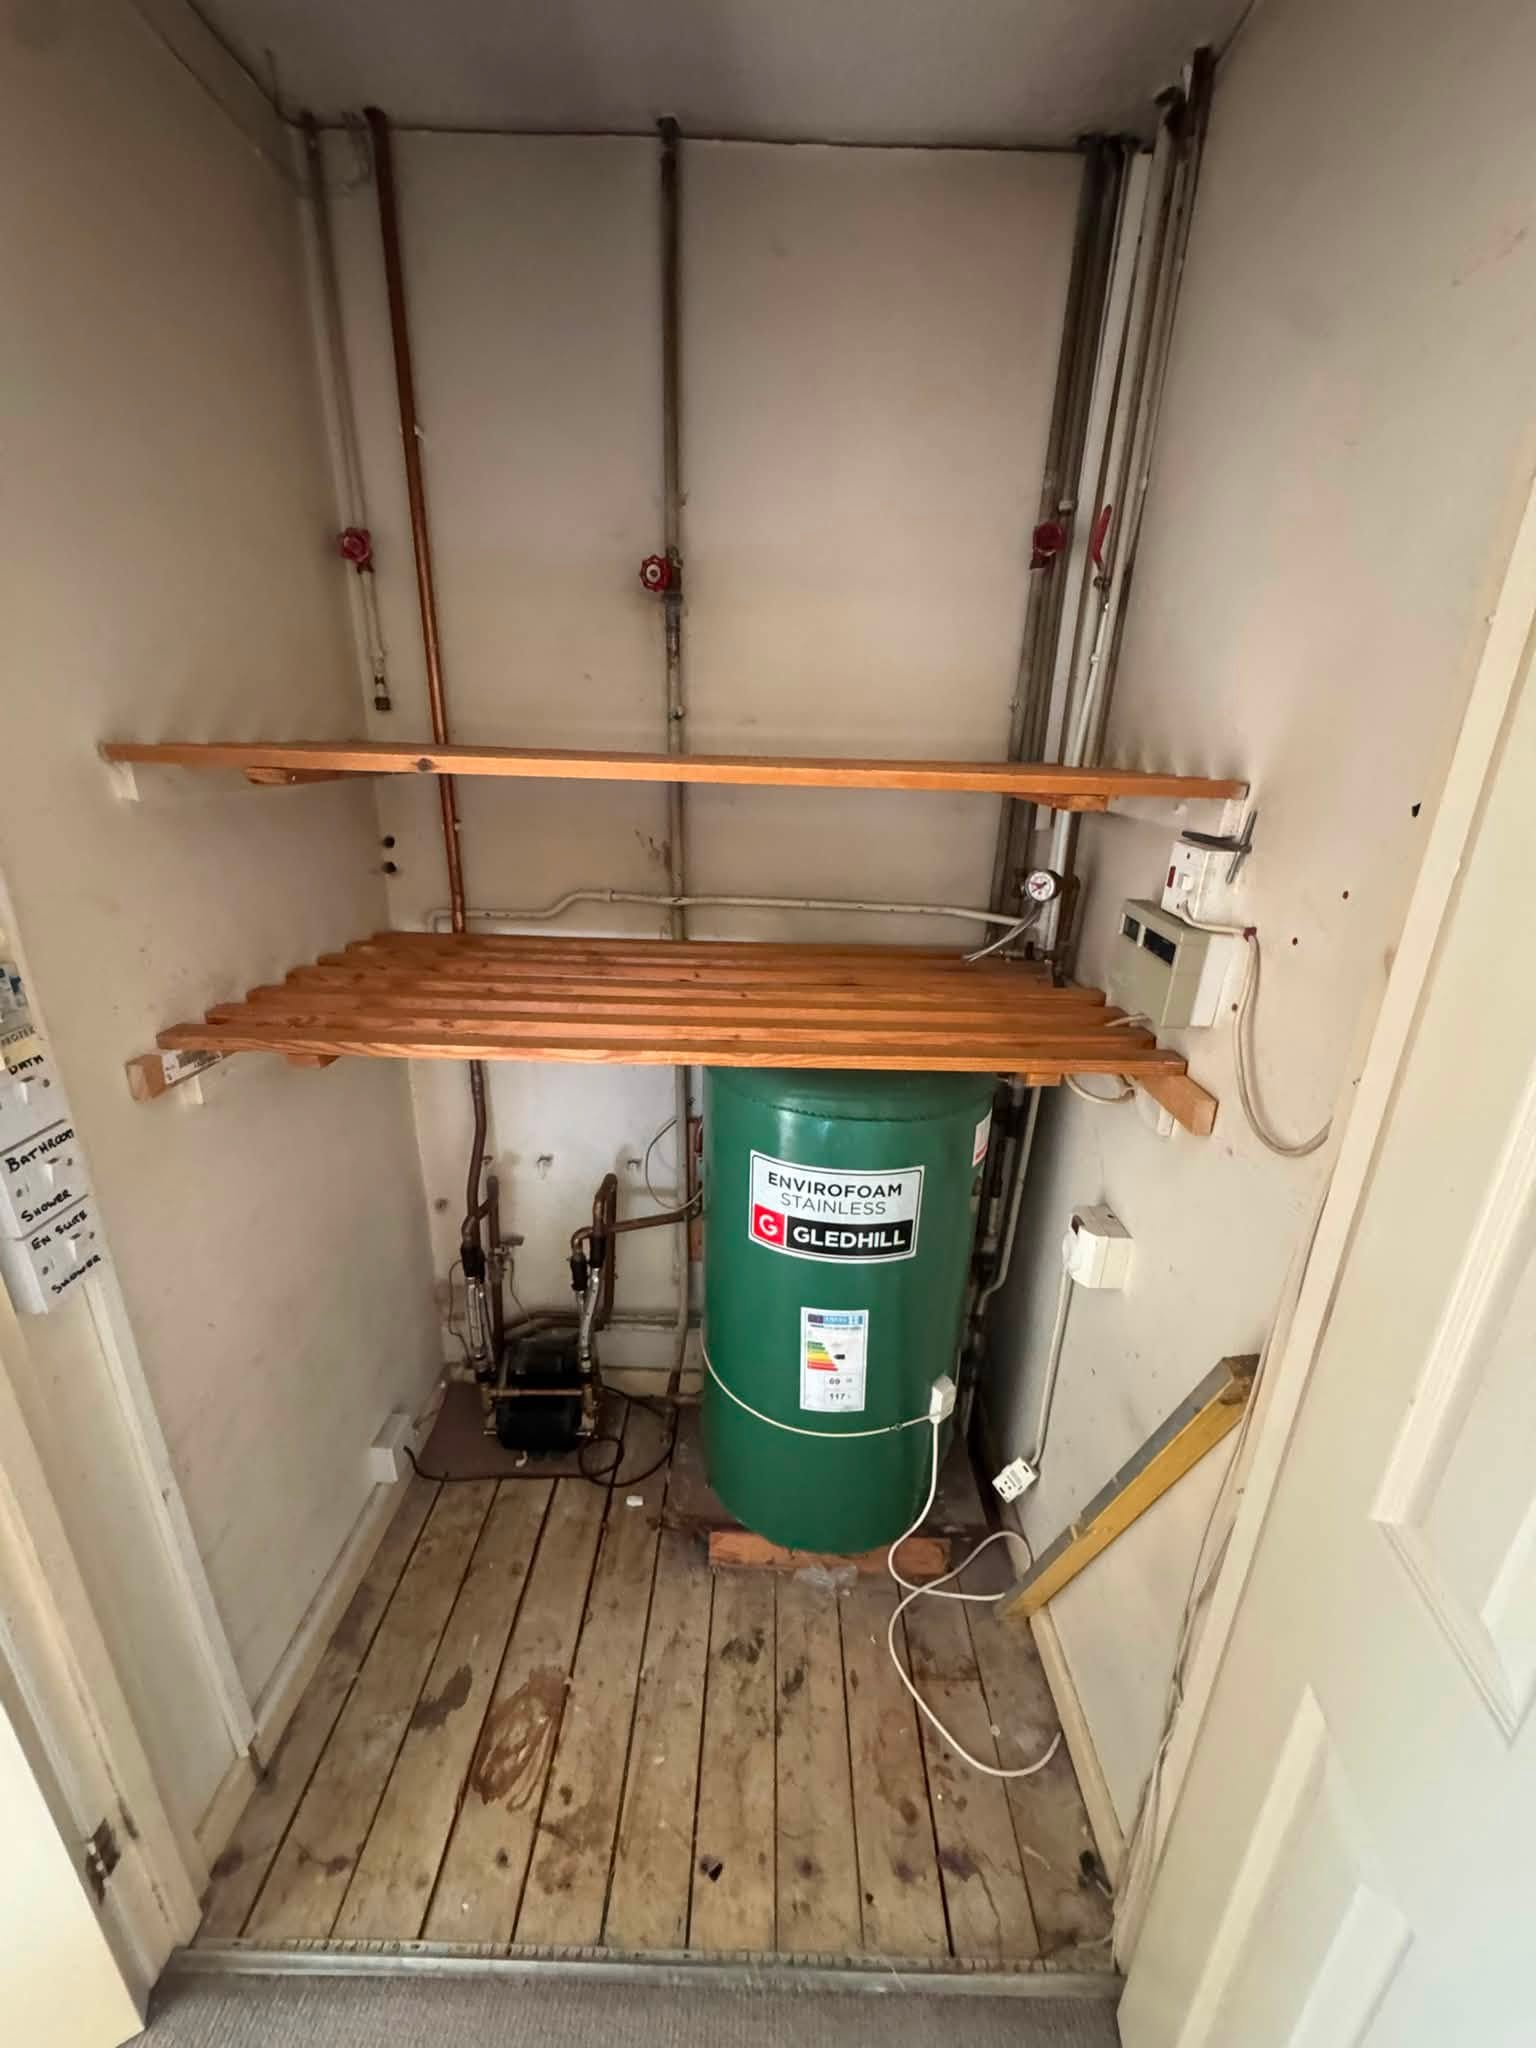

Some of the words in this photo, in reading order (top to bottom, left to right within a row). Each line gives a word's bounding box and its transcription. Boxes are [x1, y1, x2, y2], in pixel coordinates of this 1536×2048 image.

[5, 1128, 74, 1173] BATHROOM
[768, 1171, 902, 1198] ENVIROFOAM
[21, 1189, 72, 1222] SHOWER
[780, 1192, 886, 1216] STAINLESS
[758, 1214, 778, 1236] G
[792, 1226, 906, 1249] GLEDHILL
[51, 1254, 102, 1294] SHOWER
